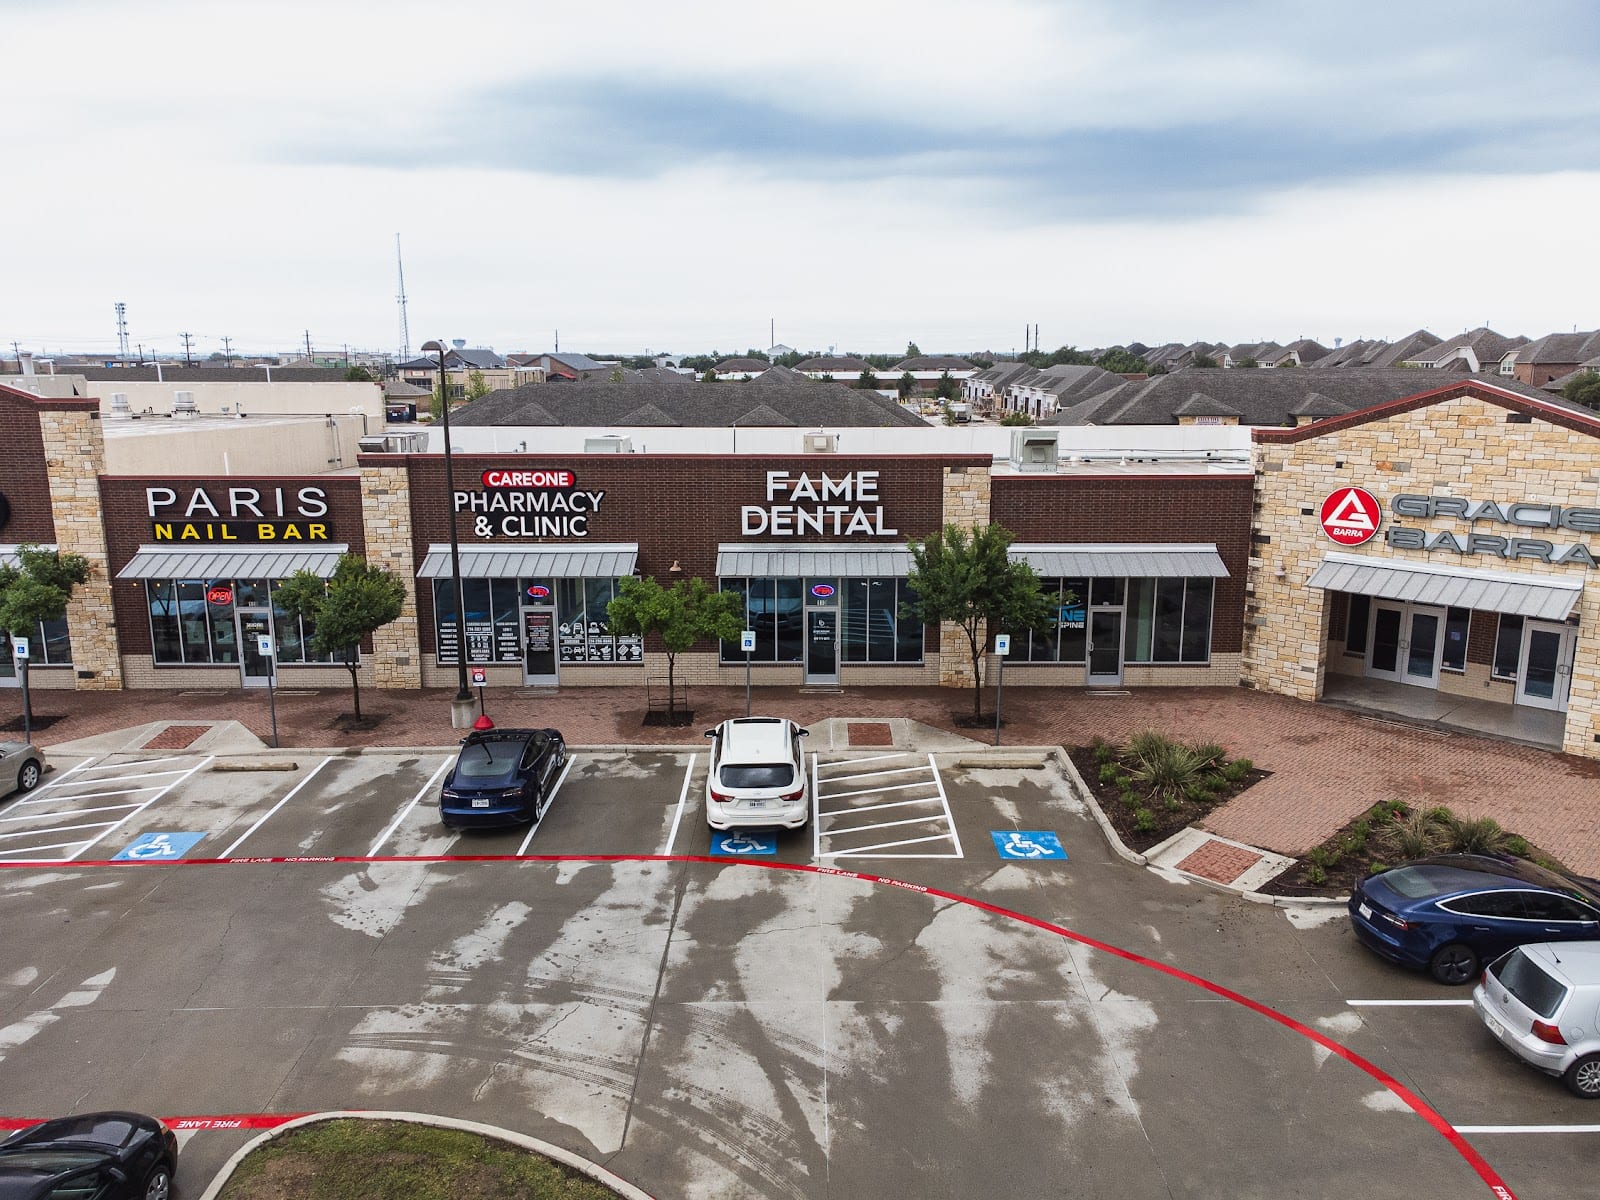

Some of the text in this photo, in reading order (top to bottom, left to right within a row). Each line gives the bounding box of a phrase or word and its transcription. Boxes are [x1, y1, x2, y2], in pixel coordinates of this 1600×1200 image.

[488, 472, 569, 487] CAREONE
[766, 471, 879, 501] FAME
[146, 487, 328, 517] PARIS
[453, 492, 604, 513] PHARMACY
[741, 506, 898, 535] DENTAL
[1391, 494, 1600, 532] GRACIE
[155, 523, 328, 540] NAIL BAR
[474, 516, 588, 537] & CLINIC
[1333, 527, 1363, 538] BARRA
[1388, 526, 1598, 569] BARRA
[208, 591, 233, 601] OPEN
[891, 880, 928, 892] PARKING
[1492, 1185, 1513, 1200] FIR
